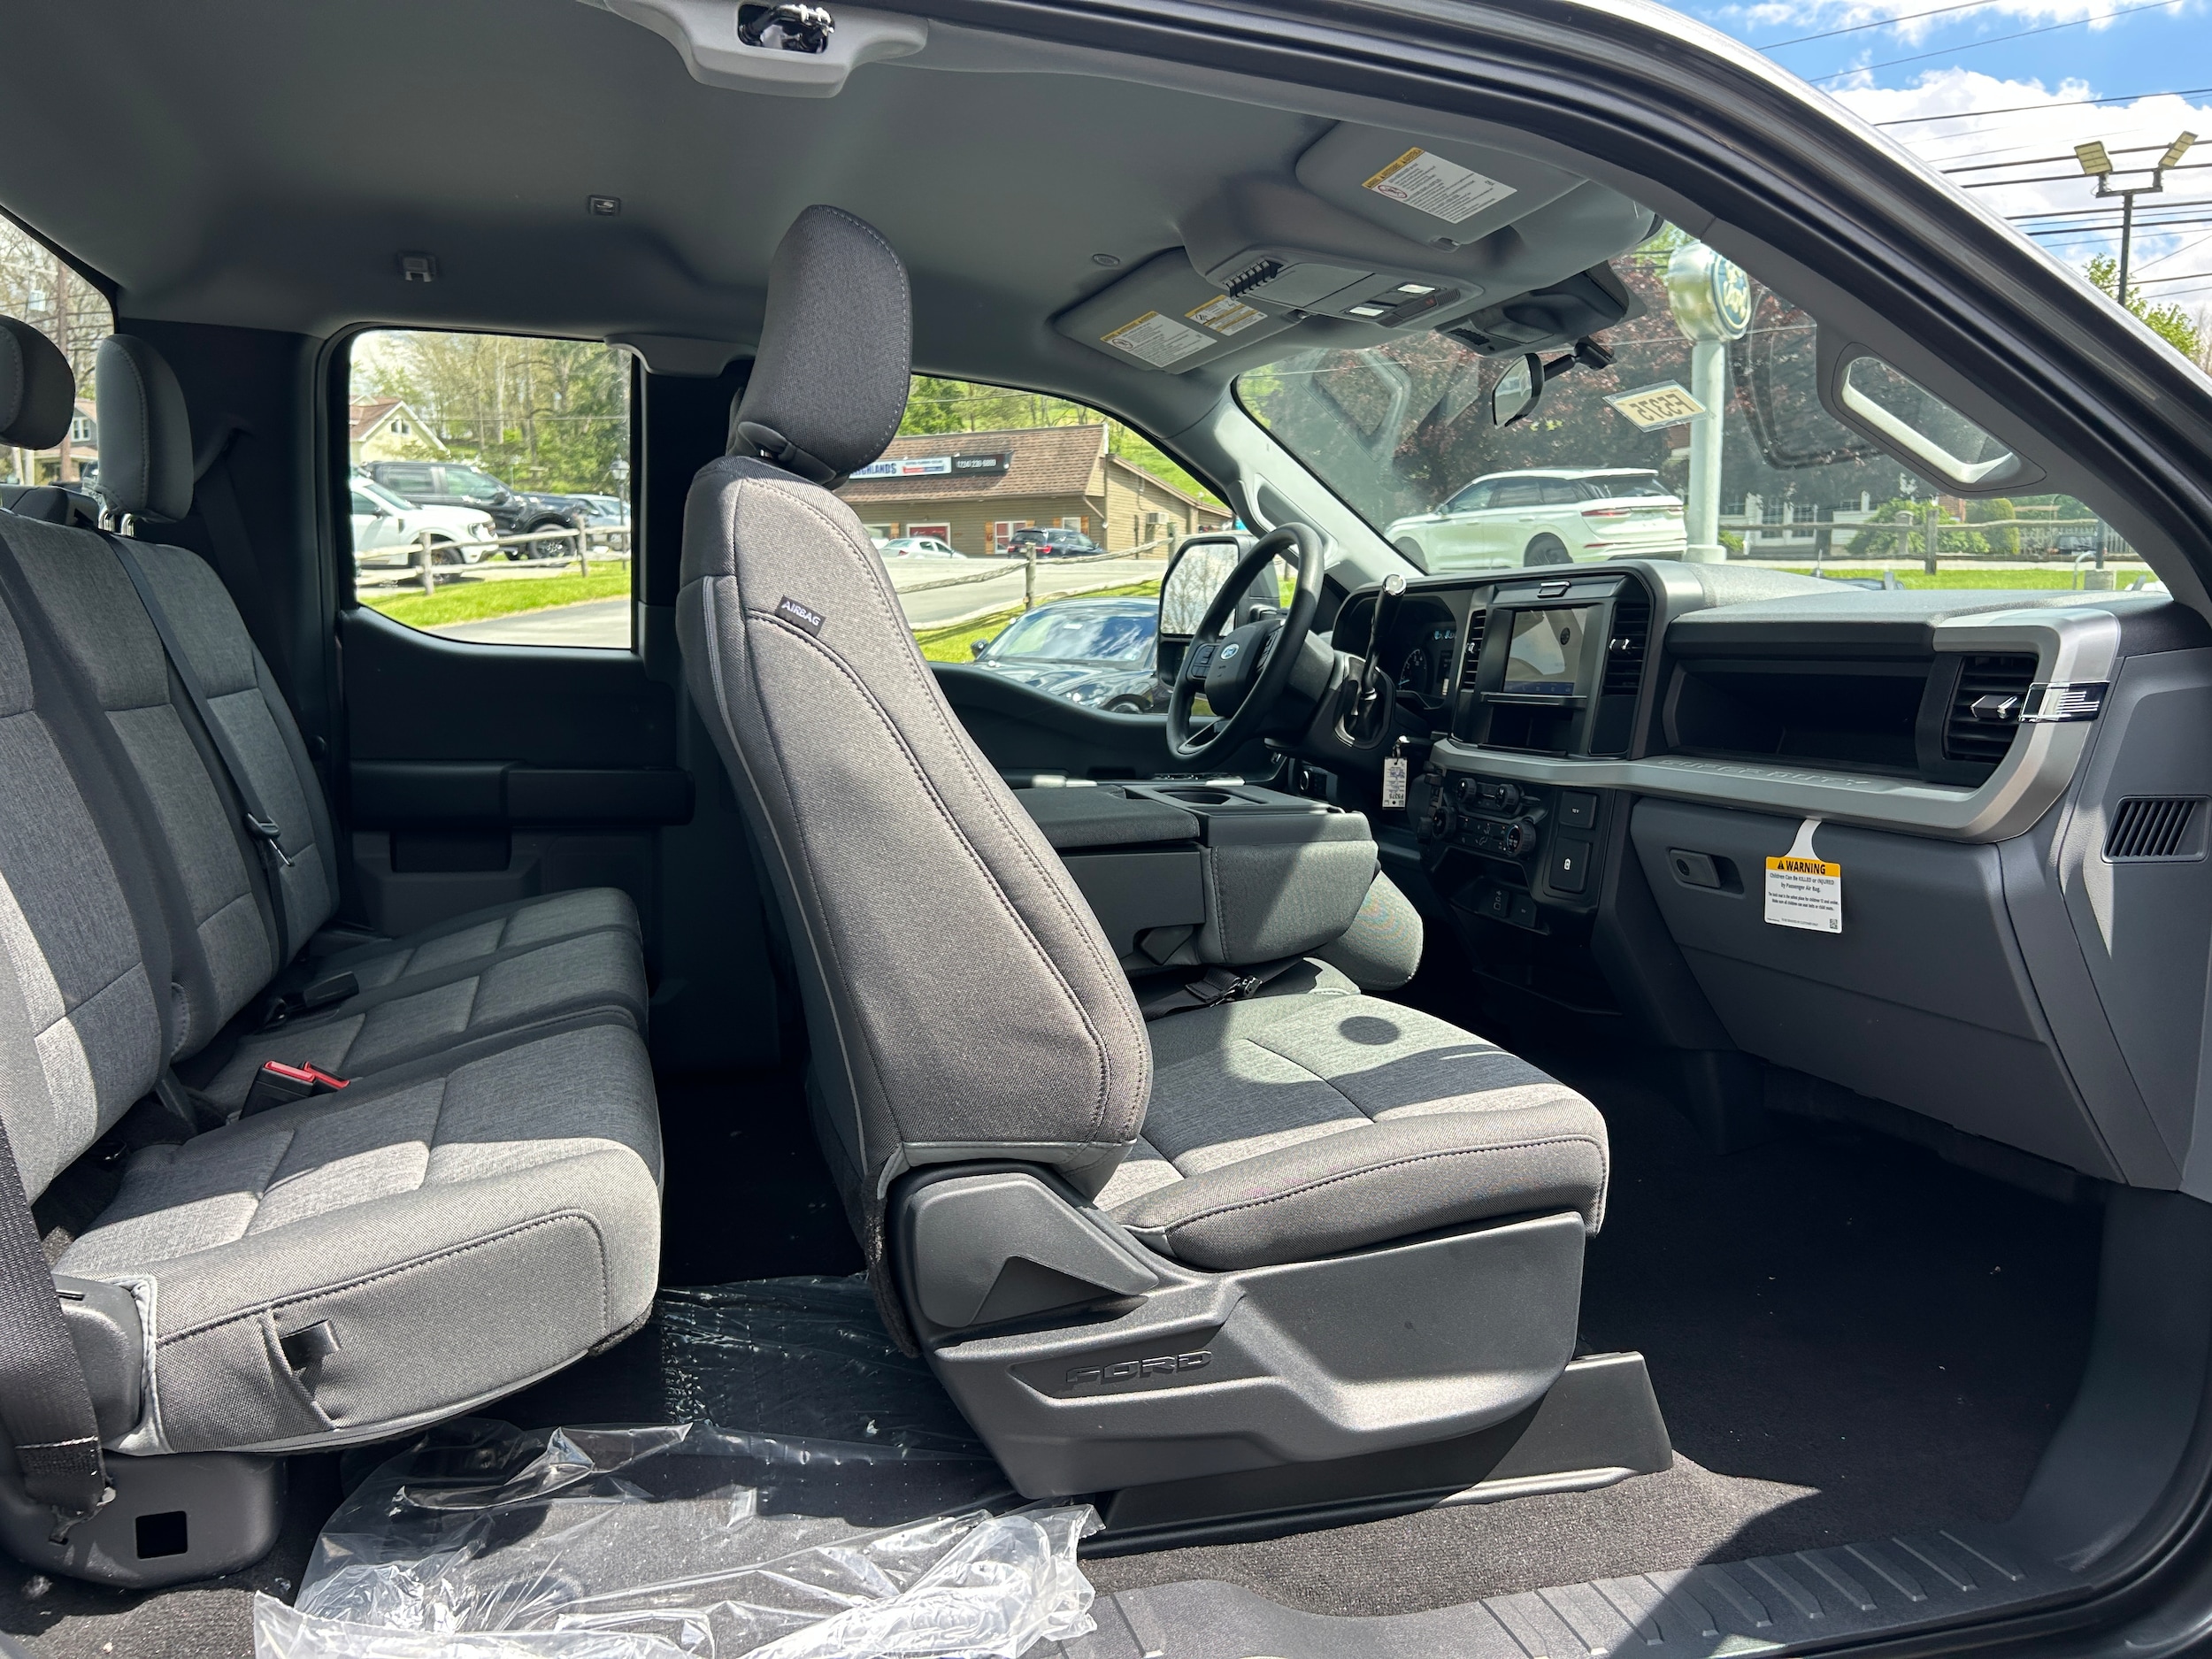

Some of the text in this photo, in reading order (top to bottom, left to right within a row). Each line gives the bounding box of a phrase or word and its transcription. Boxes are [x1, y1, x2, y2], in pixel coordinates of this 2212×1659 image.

[781, 601, 821, 626] AIRBAG
[1658, 759, 1872, 786] SUPER DUTY
[1786, 860, 1826, 875] WARNING
[1066, 1350, 1212, 1382] FORD
